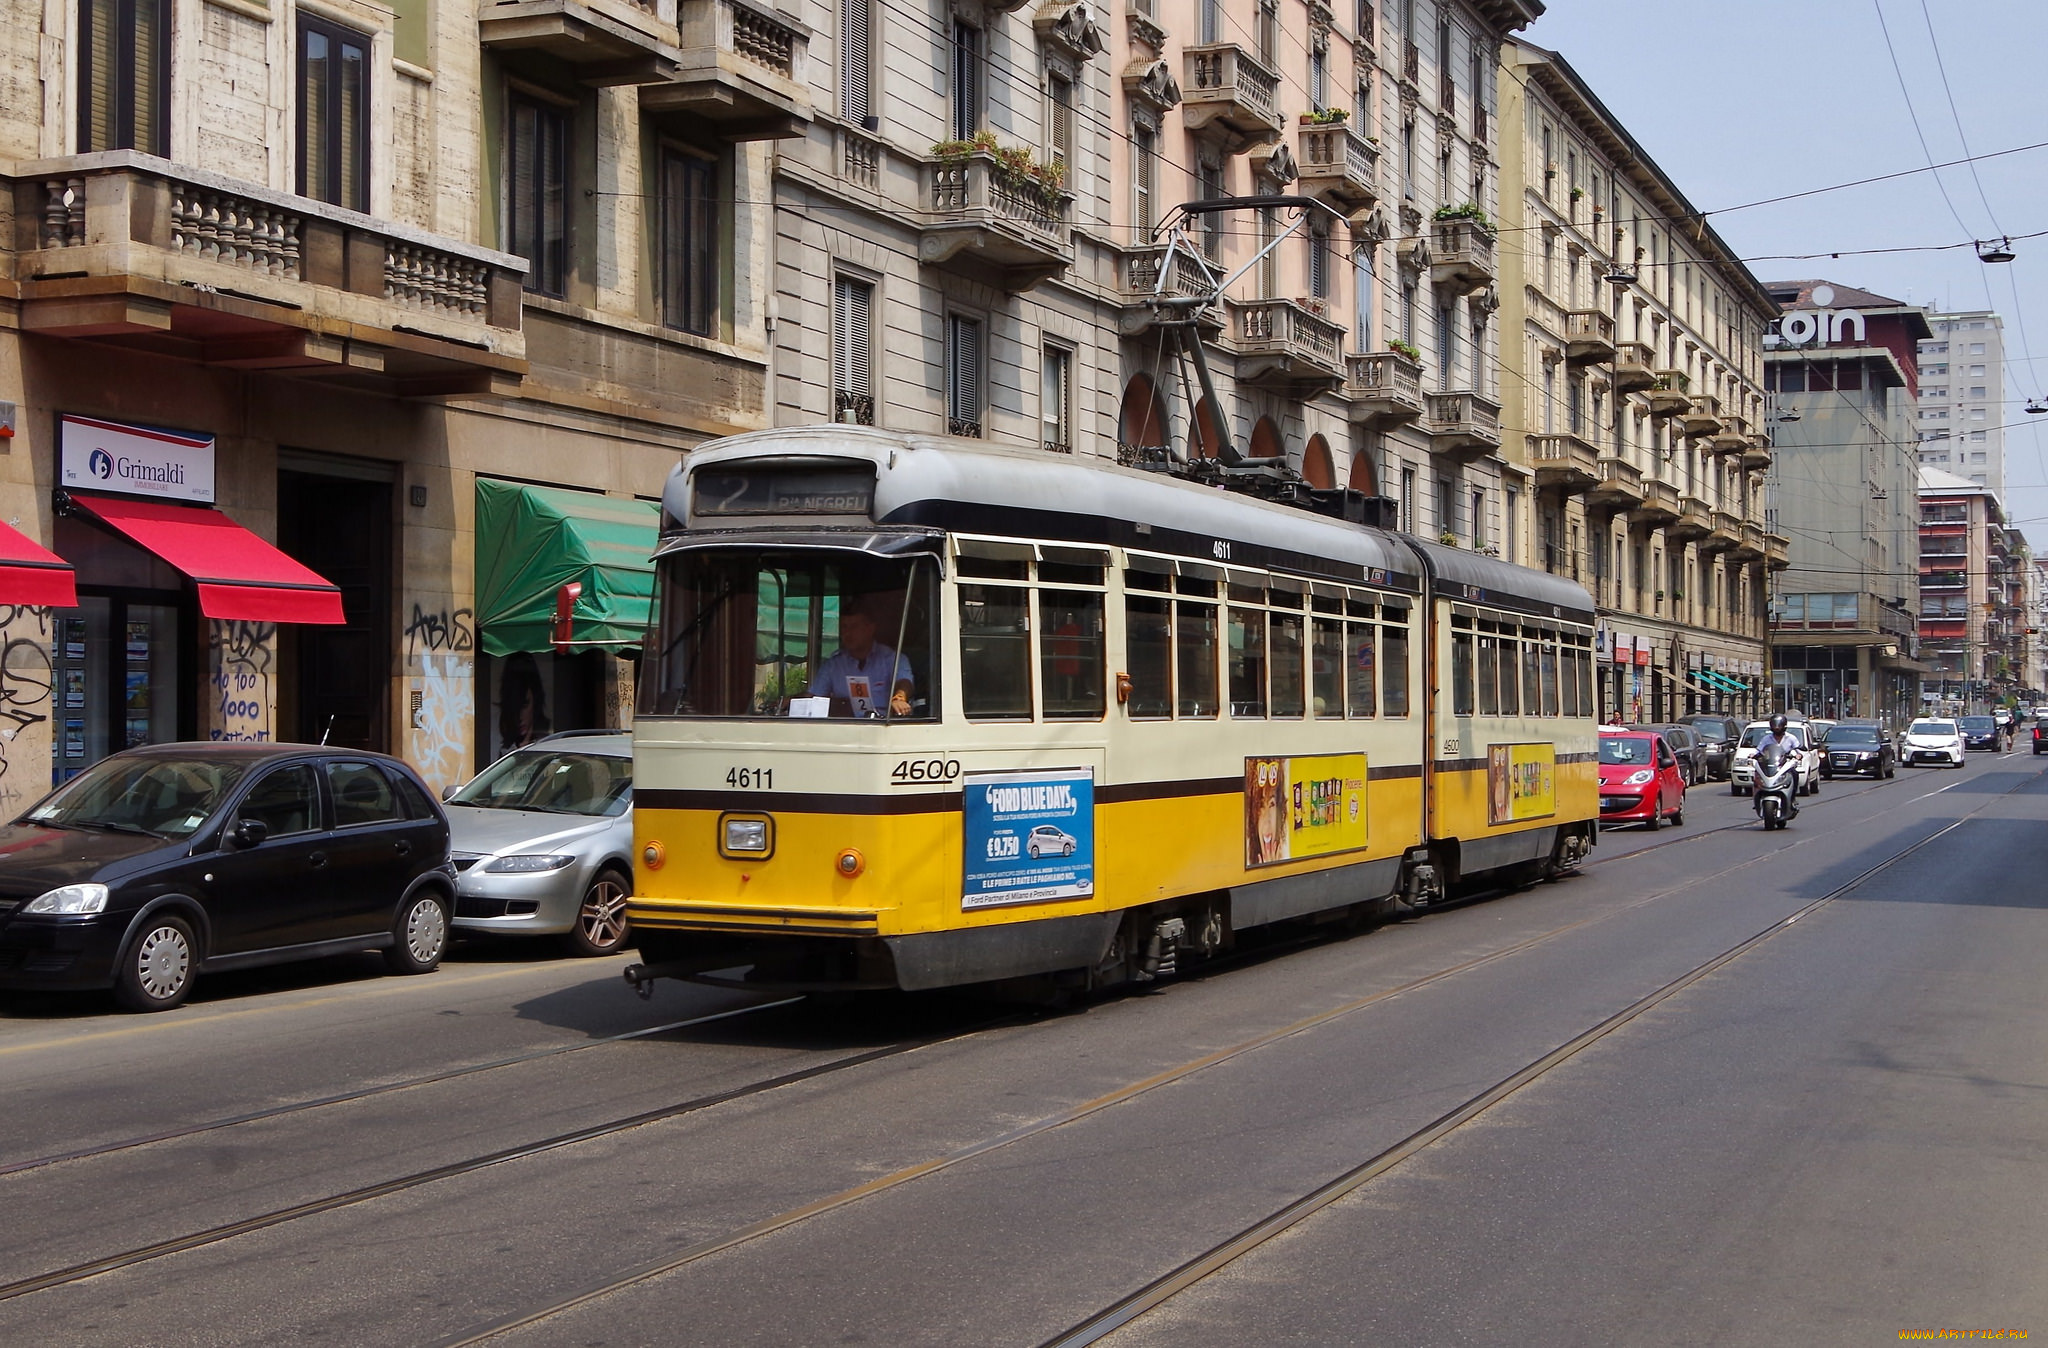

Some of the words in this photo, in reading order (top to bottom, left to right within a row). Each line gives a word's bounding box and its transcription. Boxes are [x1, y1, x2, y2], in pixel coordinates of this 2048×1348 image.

[1763, 285, 1866, 345] oin
[117, 457, 185, 485] Grimaldi
[1213, 540, 1232, 560] 4611
[235, 666, 257, 693] 100
[219, 690, 260, 726] 1000
[858, 699, 868, 711] 2
[1443, 739, 1460, 752] 4600
[726, 767, 773, 790] 4611
[891, 760, 961, 781] 4600
[1020, 786, 1046, 811] BLUE
[971, 895, 984, 904] Ford
[984, 893, 1005, 903] Partner
[1011, 891, 1029, 900] Milano
[1033, 889, 1057, 898] Provincia
